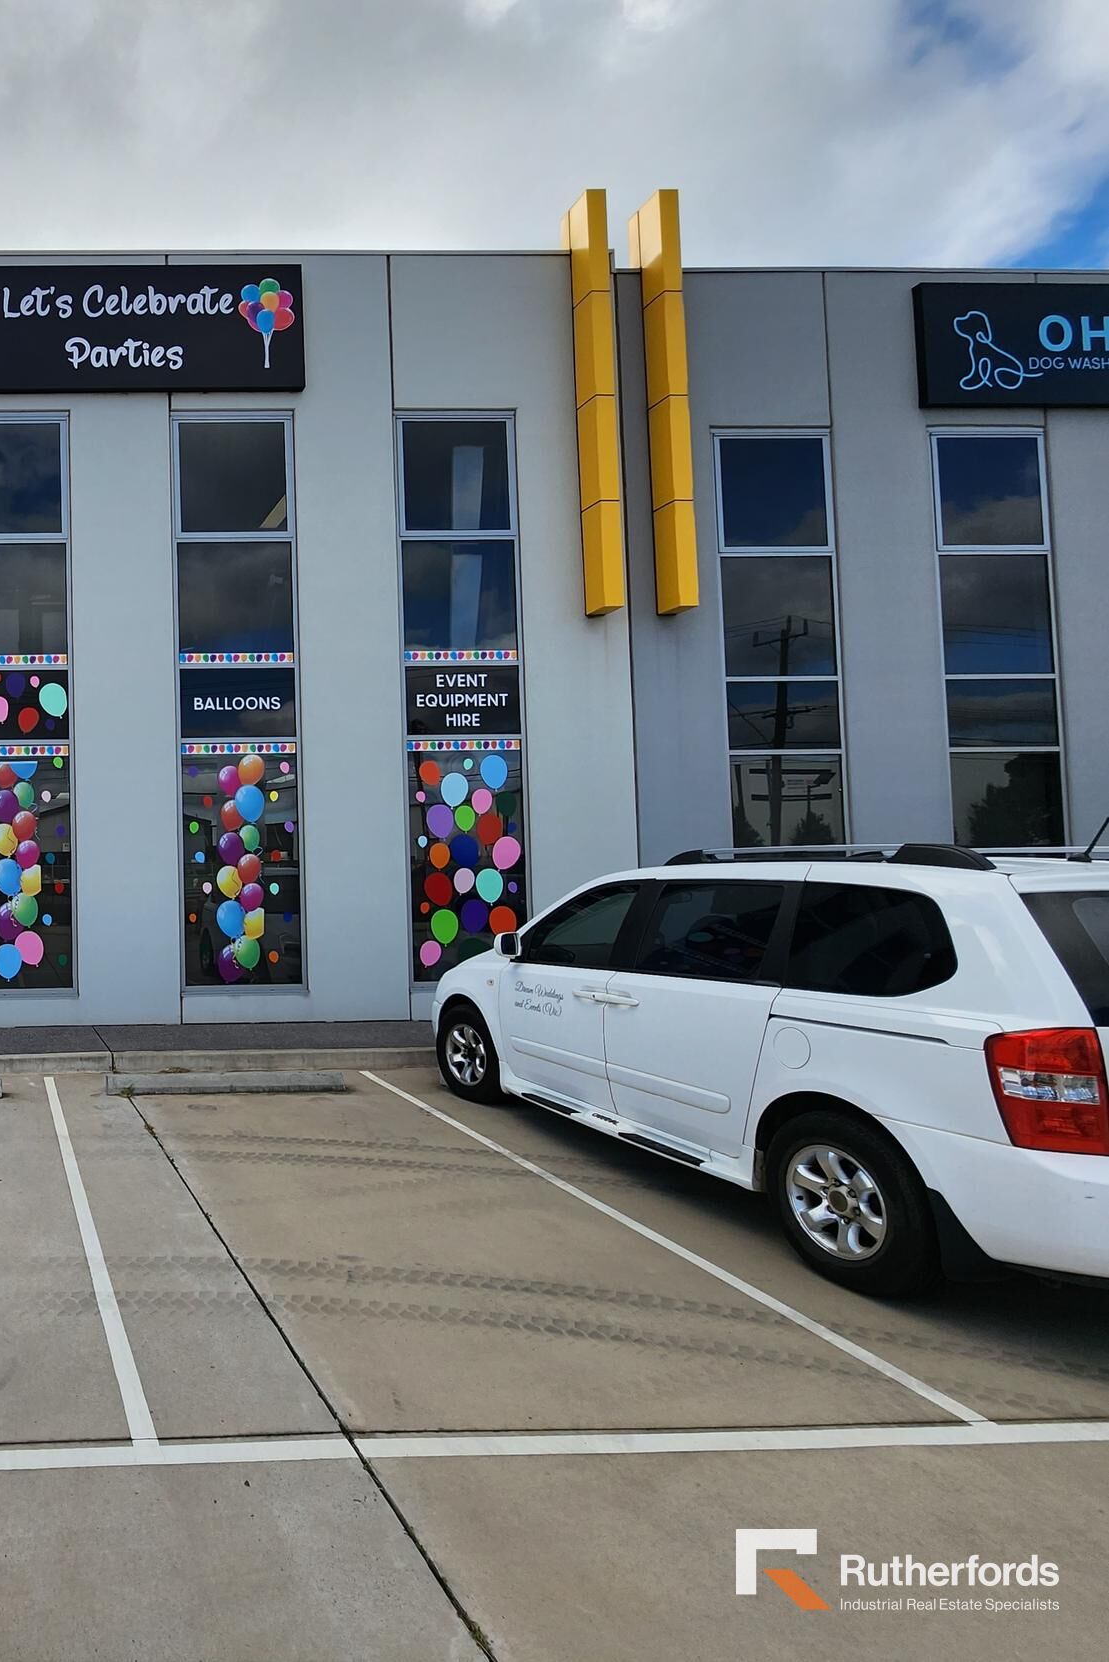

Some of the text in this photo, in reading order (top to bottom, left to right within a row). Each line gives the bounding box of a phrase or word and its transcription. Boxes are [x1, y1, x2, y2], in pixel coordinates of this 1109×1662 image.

[3, 284, 235, 319] Let's Celebrate
[1039, 314, 1109, 352] OH
[64, 336, 184, 370] Parties
[1028, 356, 1065, 370] DOG
[435, 673, 488, 688] EVENT
[193, 696, 281, 711] BALLOONS
[416, 693, 509, 708] EQUIPMENT
[445, 713, 481, 727] HIRE
[514, 980, 563, 1004] Dream Weddings
